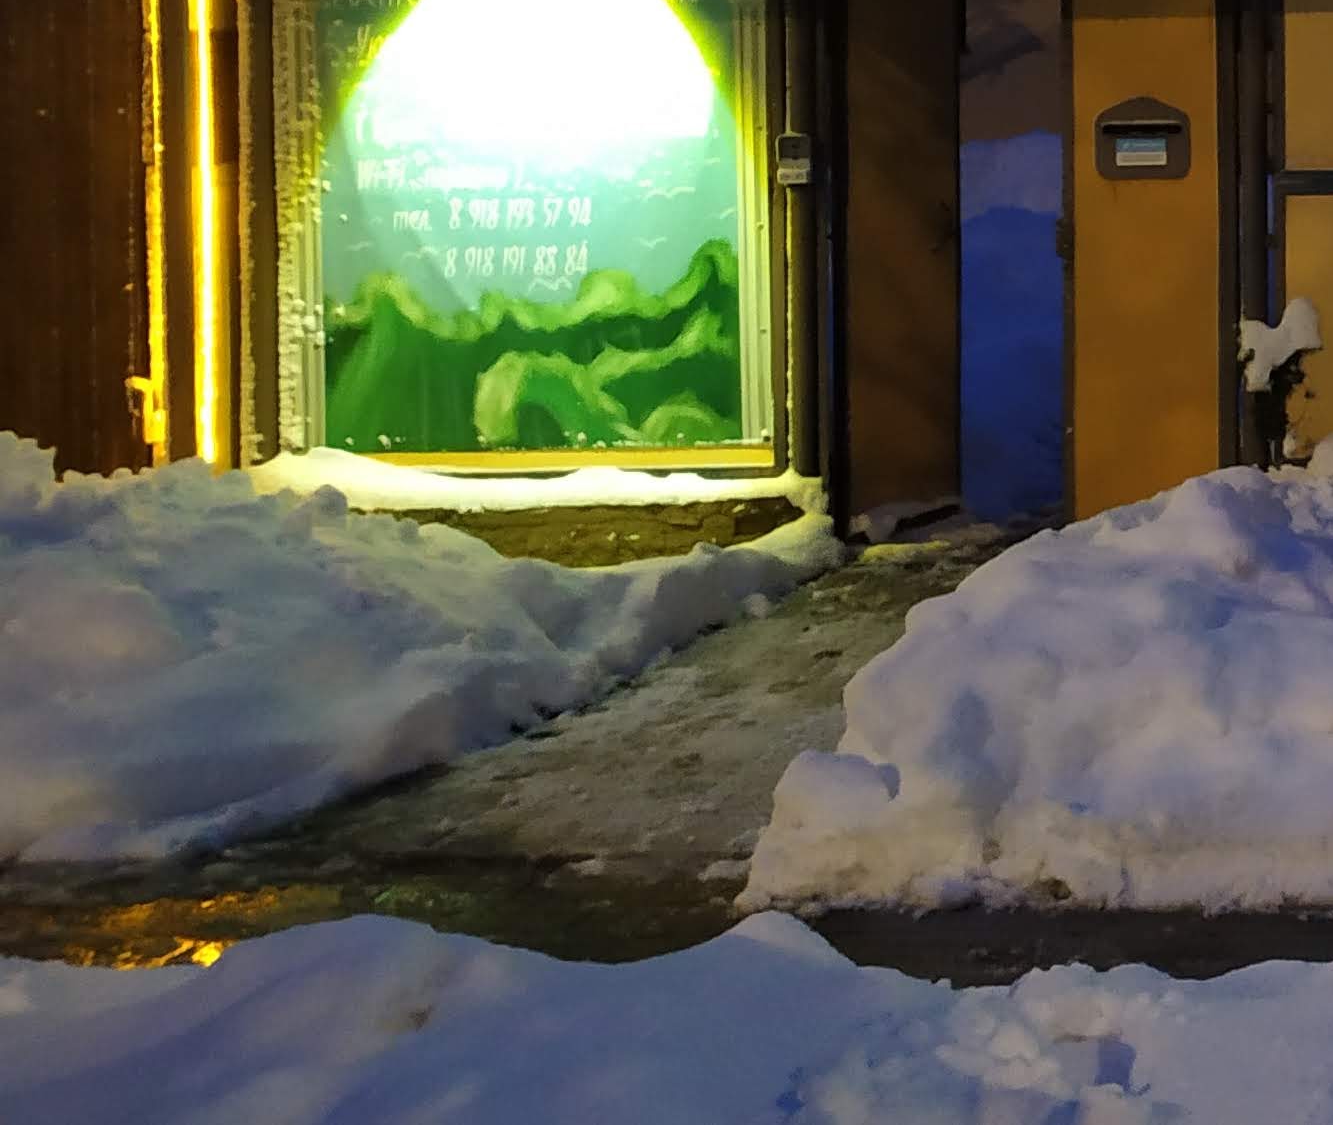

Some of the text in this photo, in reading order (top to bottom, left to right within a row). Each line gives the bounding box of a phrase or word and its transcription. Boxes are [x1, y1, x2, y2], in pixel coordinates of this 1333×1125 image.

[448, 196, 463, 230] 8
[467, 197, 499, 230] 918
[543, 196, 563, 228] 57
[568, 196, 592, 228] 94
[444, 244, 588, 278] 8 918 191 88 84
